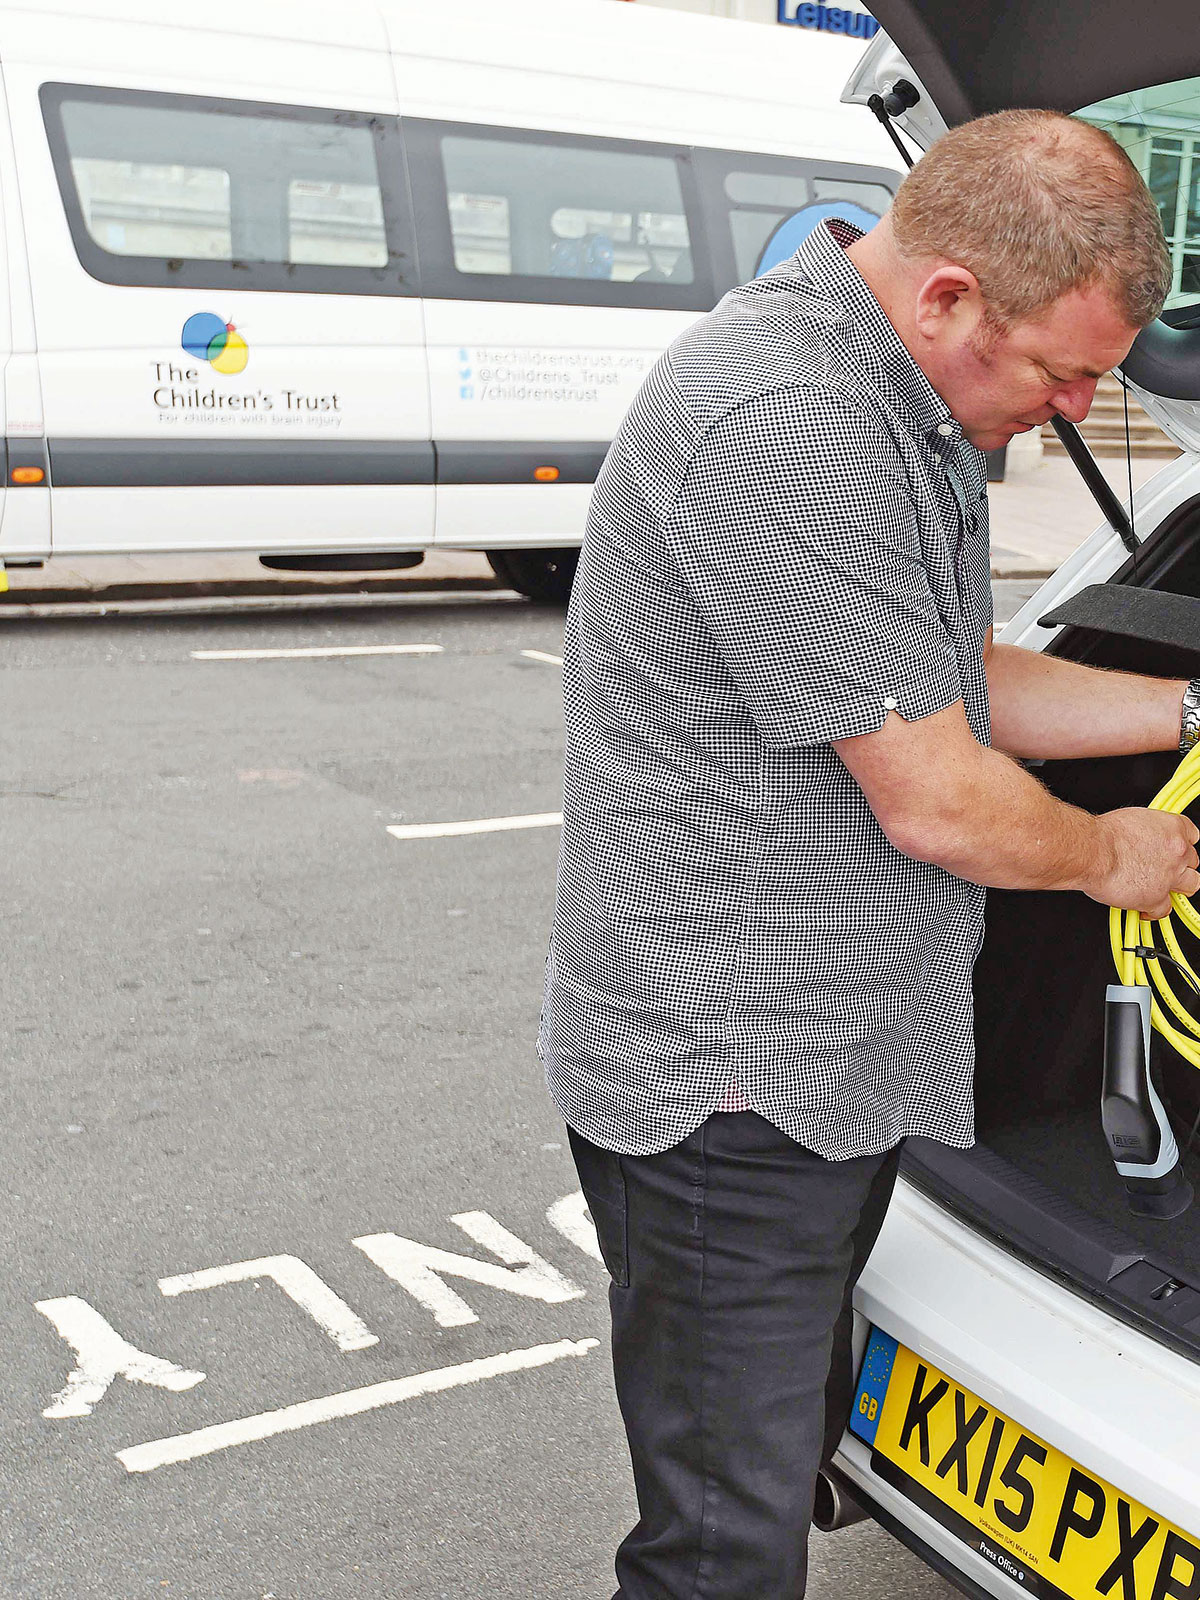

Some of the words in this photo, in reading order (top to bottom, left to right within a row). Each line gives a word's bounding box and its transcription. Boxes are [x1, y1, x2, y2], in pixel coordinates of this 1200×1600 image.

[150, 361, 199, 383] The
[153, 387, 274, 411] Children's
[281, 390, 342, 412] Trust
[159, 413, 180, 424] For
[184, 412, 236, 424] children
[240, 414, 267, 425] with
[271, 414, 303, 426] brain
[306, 416, 343, 429] injury
[858, 1391, 879, 1422] GB
[899, 1363, 1048, 1533] KX15
[978, 1515, 1004, 1540] Volkswagen
[979, 1541, 997, 1561] Press
[997, 1555, 1018, 1576] Office
